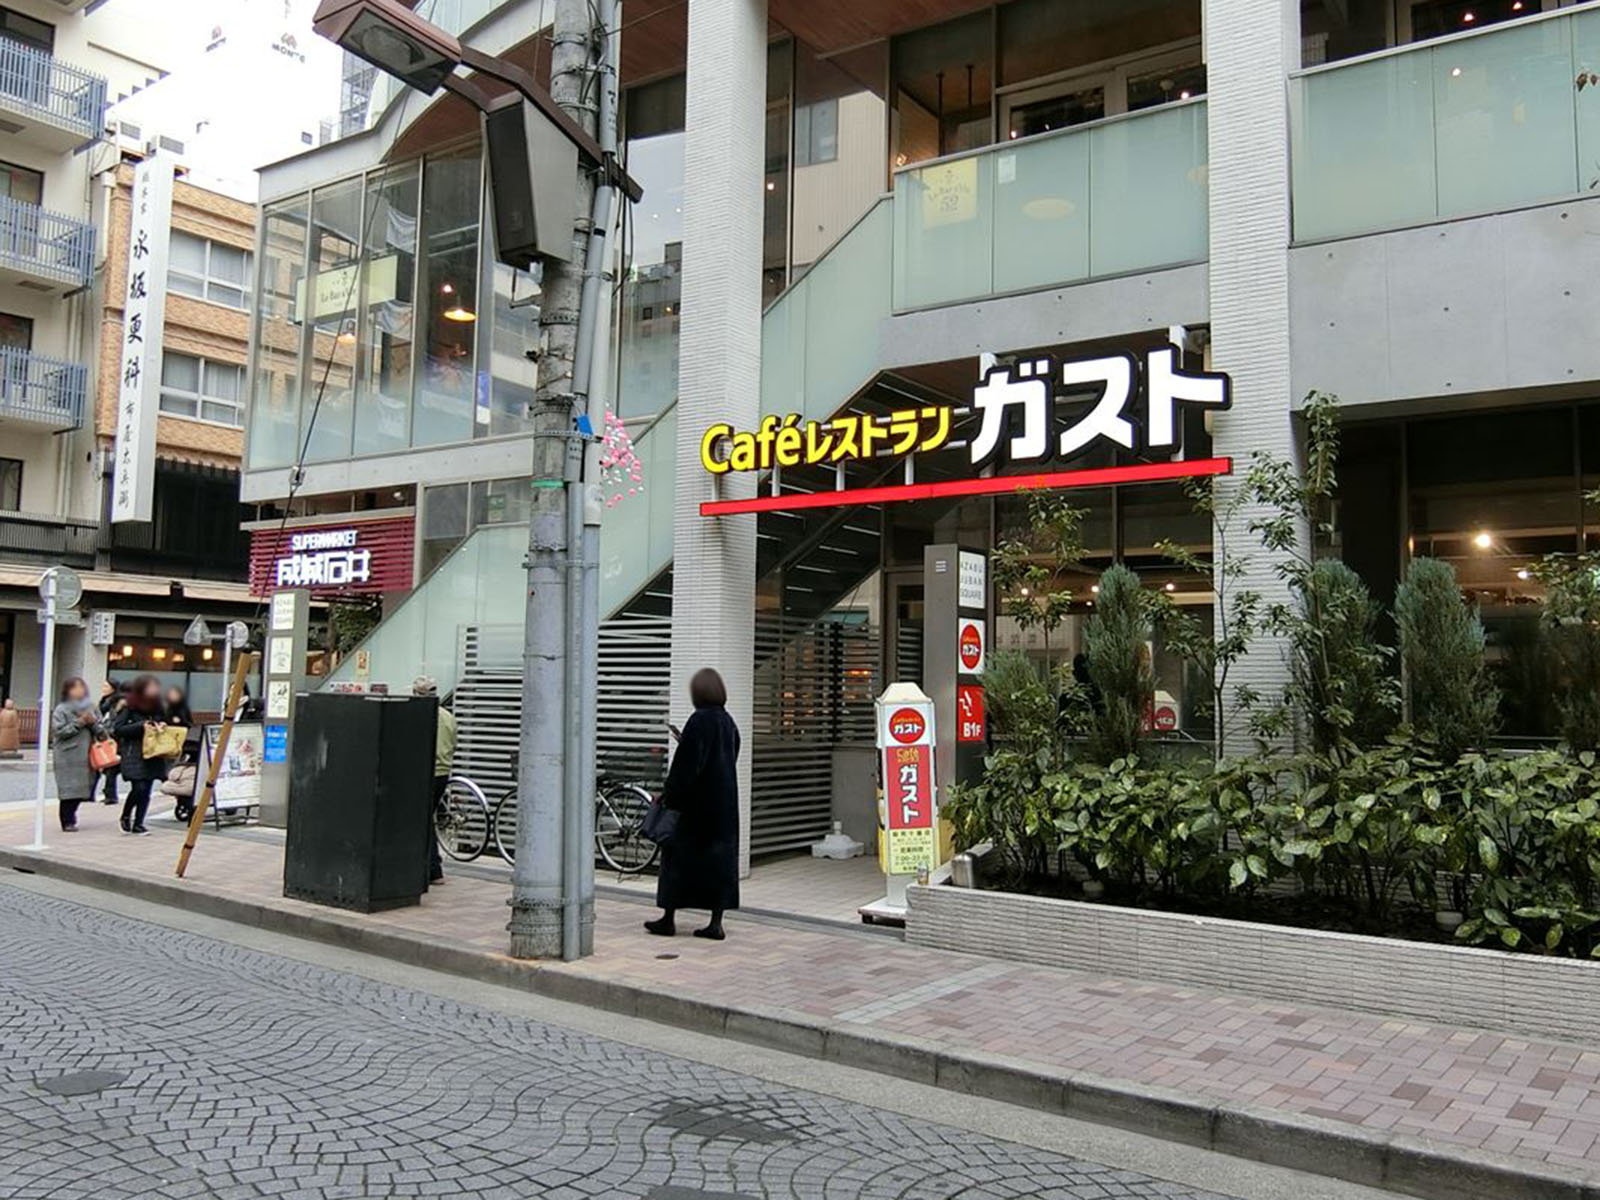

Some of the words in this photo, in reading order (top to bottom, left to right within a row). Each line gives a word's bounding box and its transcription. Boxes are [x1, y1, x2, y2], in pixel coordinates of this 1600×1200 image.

[970, 348, 1230, 466] ガスト
[291, 529, 358, 550] SUPERMARKET
[276, 549, 372, 587] 成城石井
[893, 723, 922, 735] ガスト
[963, 722, 982, 738] B1F
[900, 764, 919, 824] ガスト
